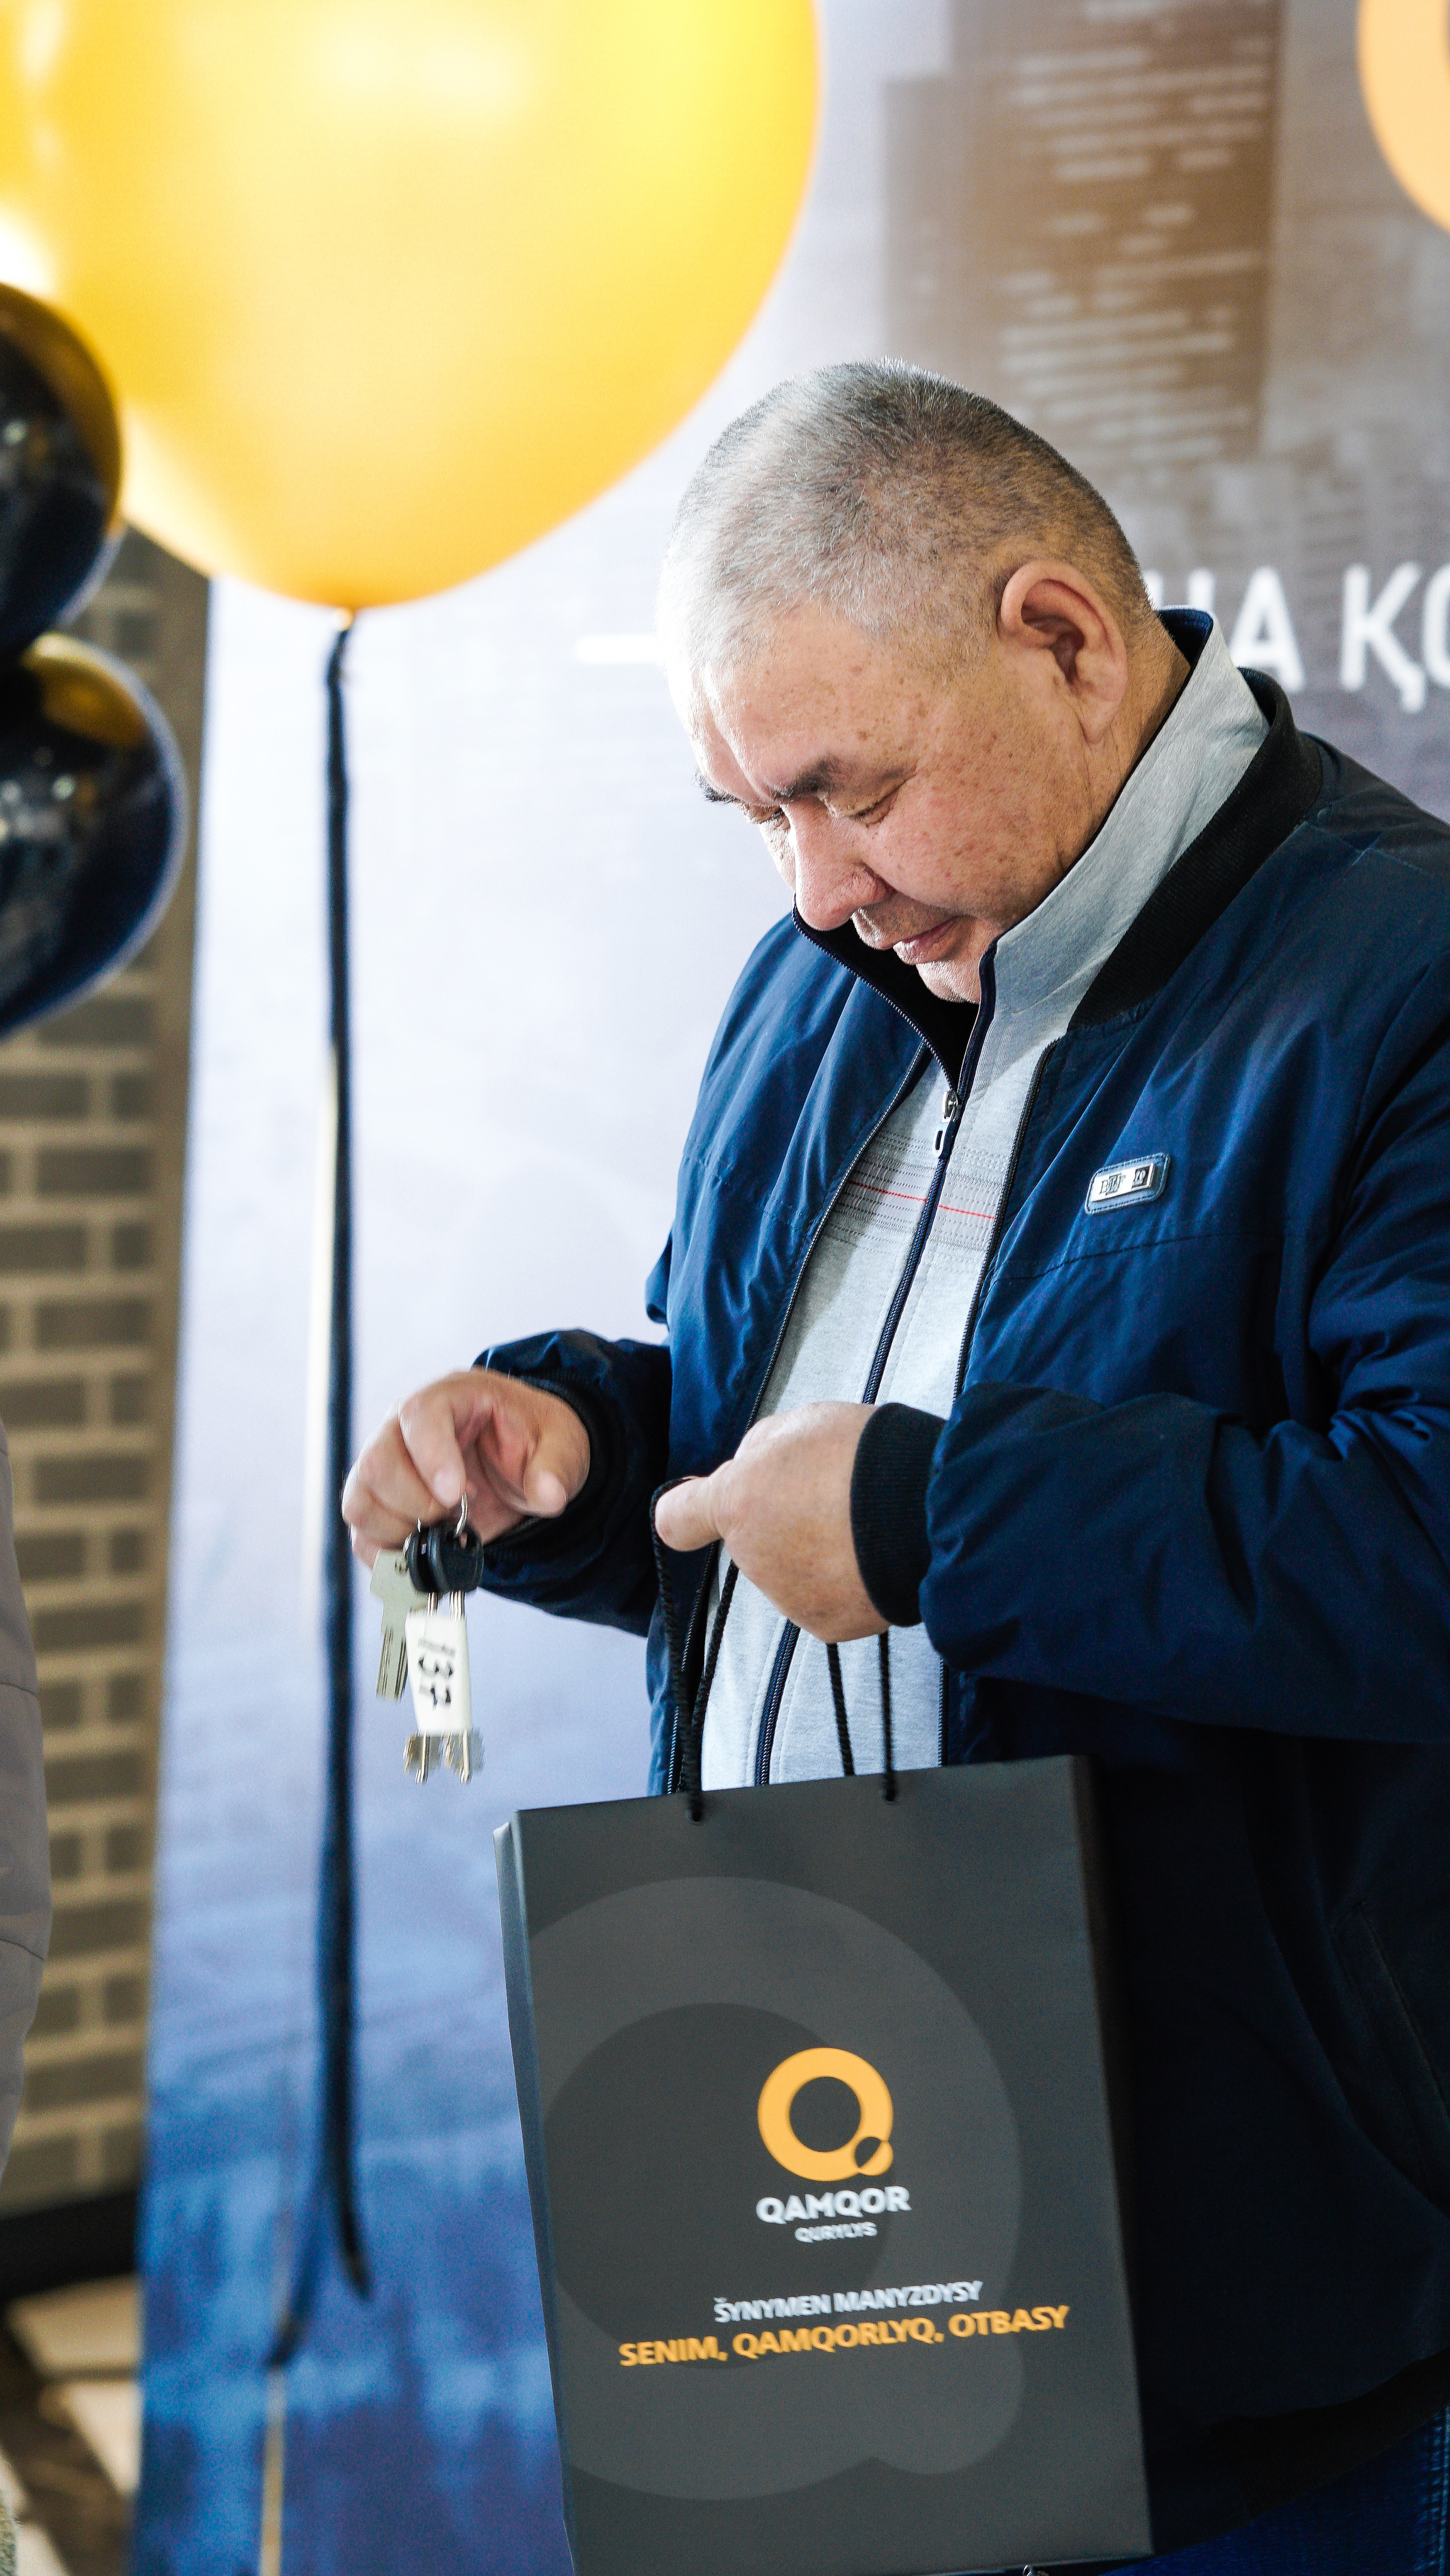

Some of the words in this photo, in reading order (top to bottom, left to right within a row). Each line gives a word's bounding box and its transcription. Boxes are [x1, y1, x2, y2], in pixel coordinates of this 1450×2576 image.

[757, 2047, 894, 2182] Q
[756, 2185, 912, 2225] QAMQOR
[794, 2221, 878, 2243] QURYLYS
[832, 2280, 983, 2312] MANYZDYSY
[947, 2304, 1070, 2338] OTBASY
